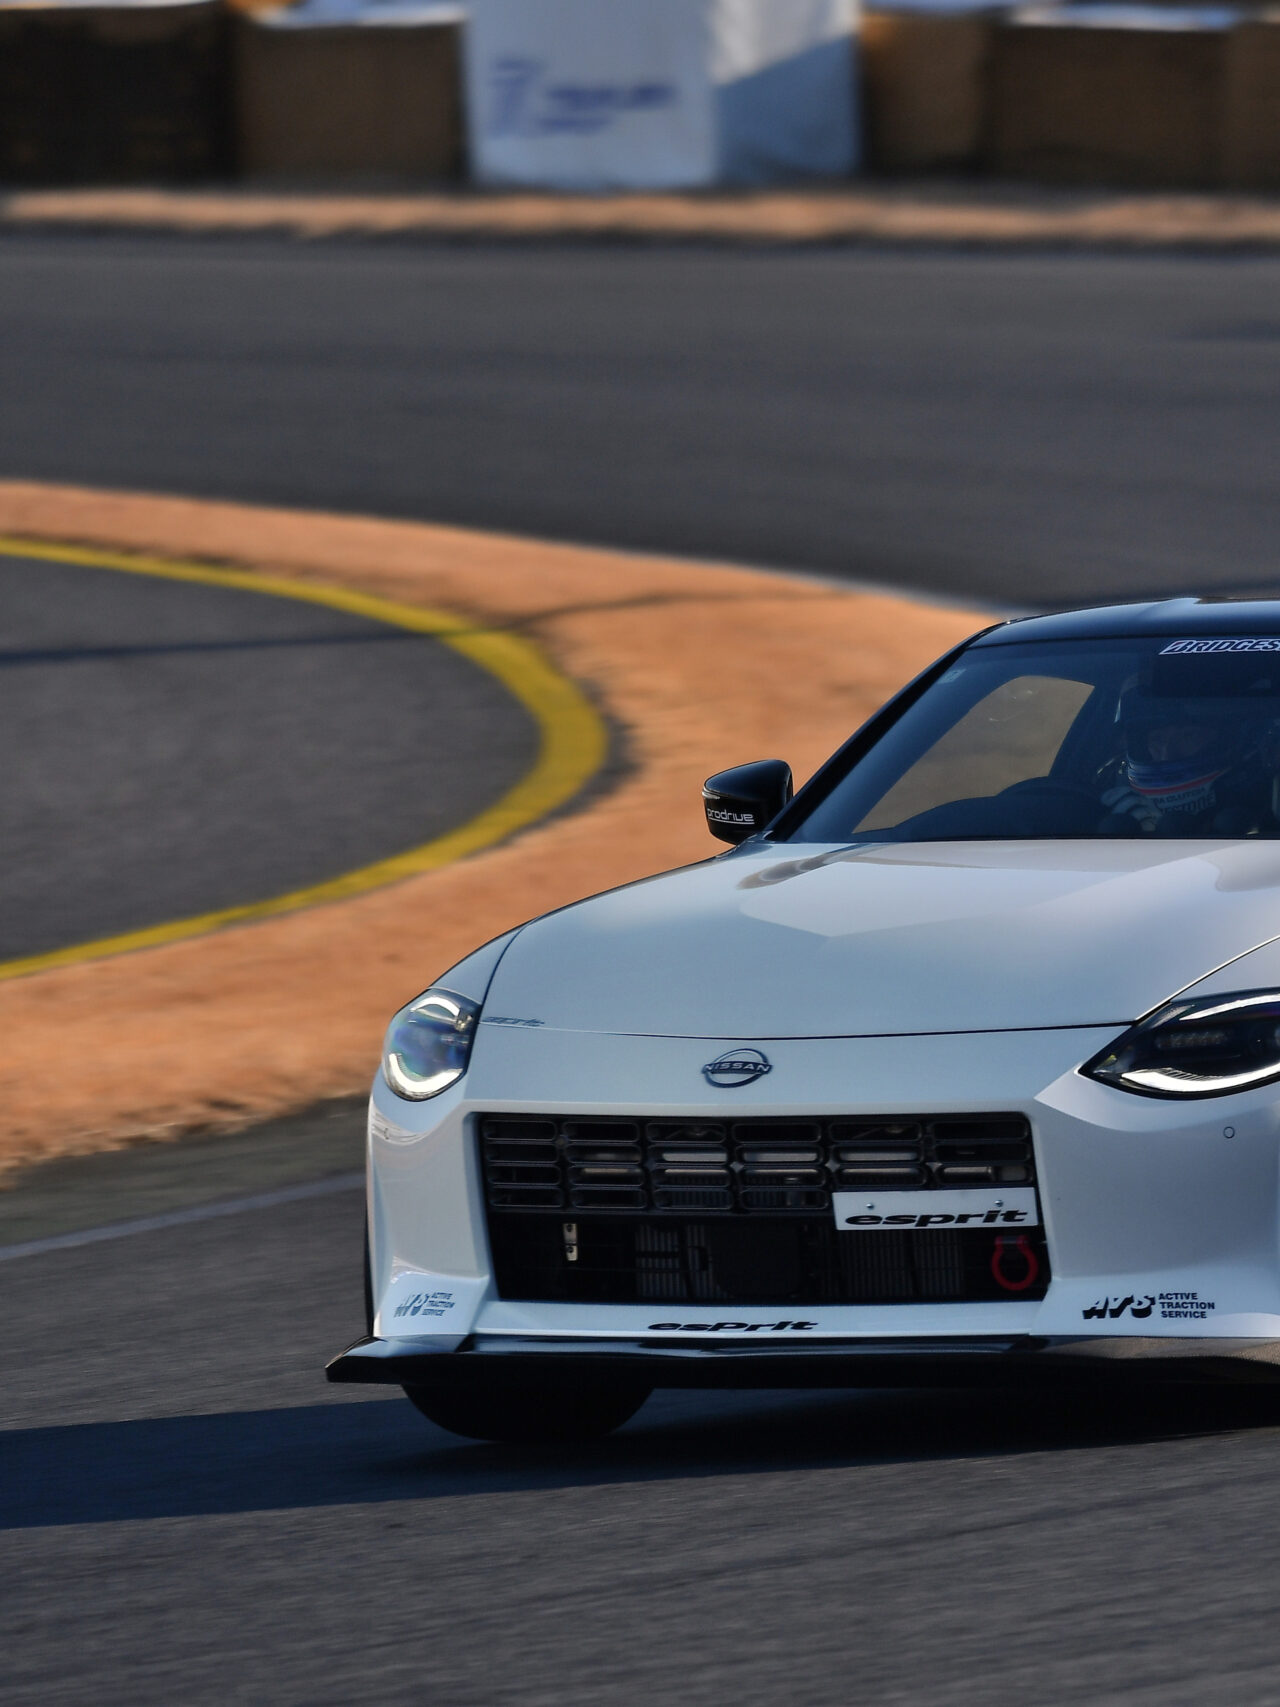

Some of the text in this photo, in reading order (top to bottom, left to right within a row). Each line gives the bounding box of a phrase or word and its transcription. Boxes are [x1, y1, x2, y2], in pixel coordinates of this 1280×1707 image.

[706, 807, 755, 823] prodrive
[704, 1062, 771, 1073] NISSAN
[844, 1209, 1028, 1228] esprit
[1158, 1292, 1199, 1301] ACTIVE
[1159, 1301, 1215, 1310] TRACTION
[1161, 1310, 1208, 1319] SERVICE
[647, 1320, 819, 1332] esprit
